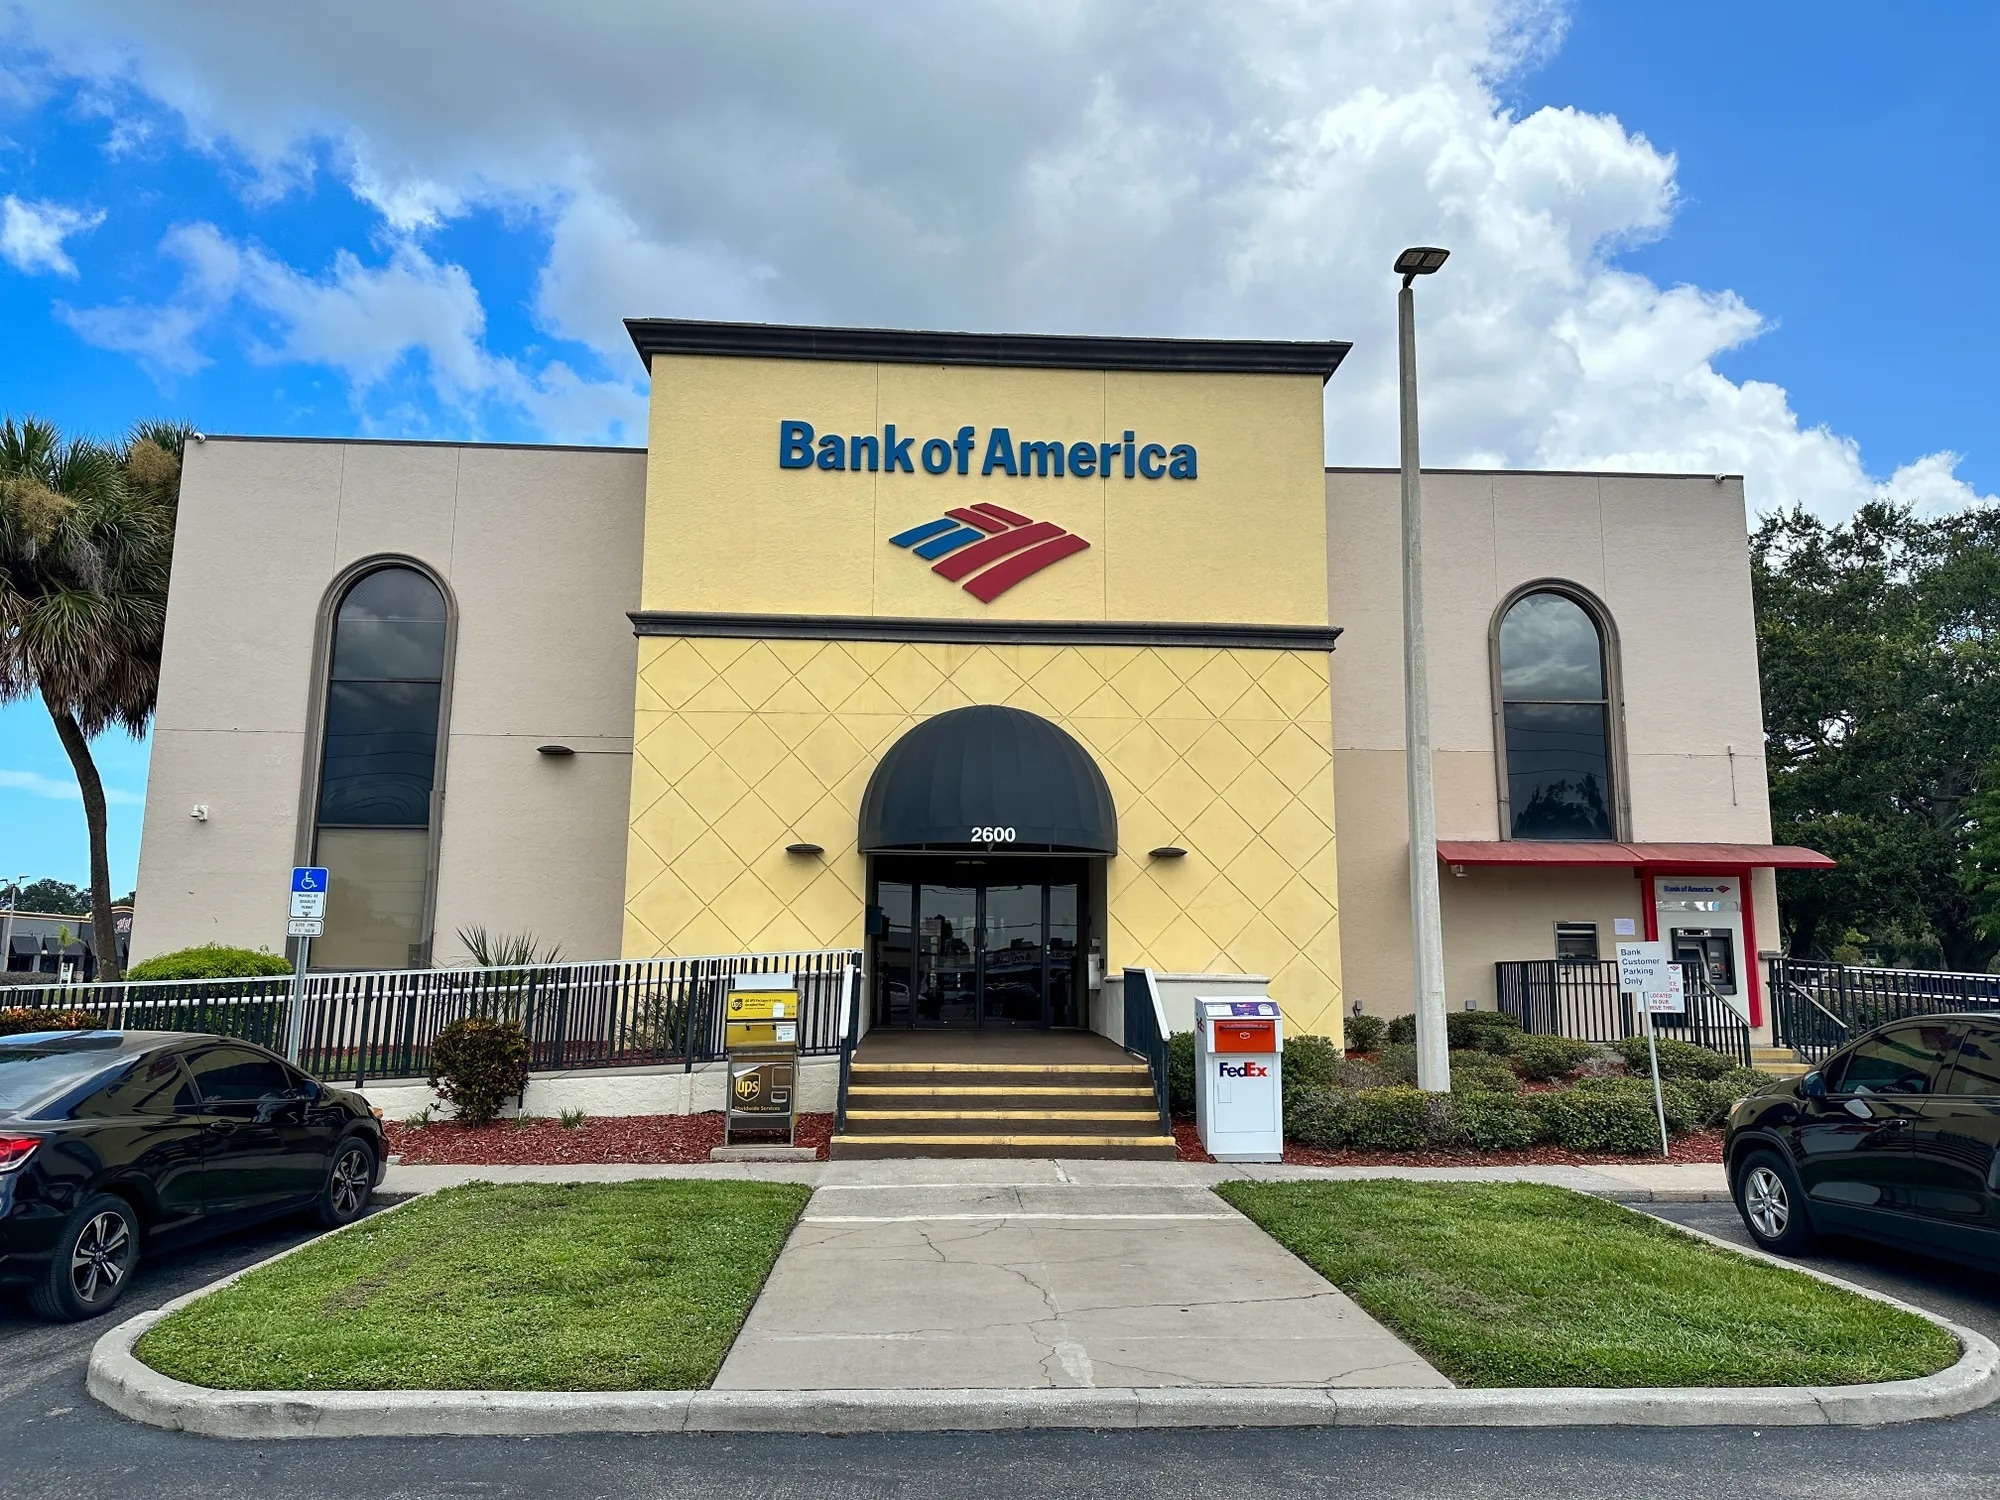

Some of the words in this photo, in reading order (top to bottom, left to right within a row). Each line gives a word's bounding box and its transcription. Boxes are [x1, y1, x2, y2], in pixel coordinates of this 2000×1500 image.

[780, 420, 915, 473] Bank
[921, 426, 976, 475] of
[981, 428, 1199, 479] America
[971, 826, 1016, 842] 2600
[732, 1001, 742, 1009] ups
[1219, 1062, 1267, 1077] FedEx
[738, 1080, 758, 1096] ups
